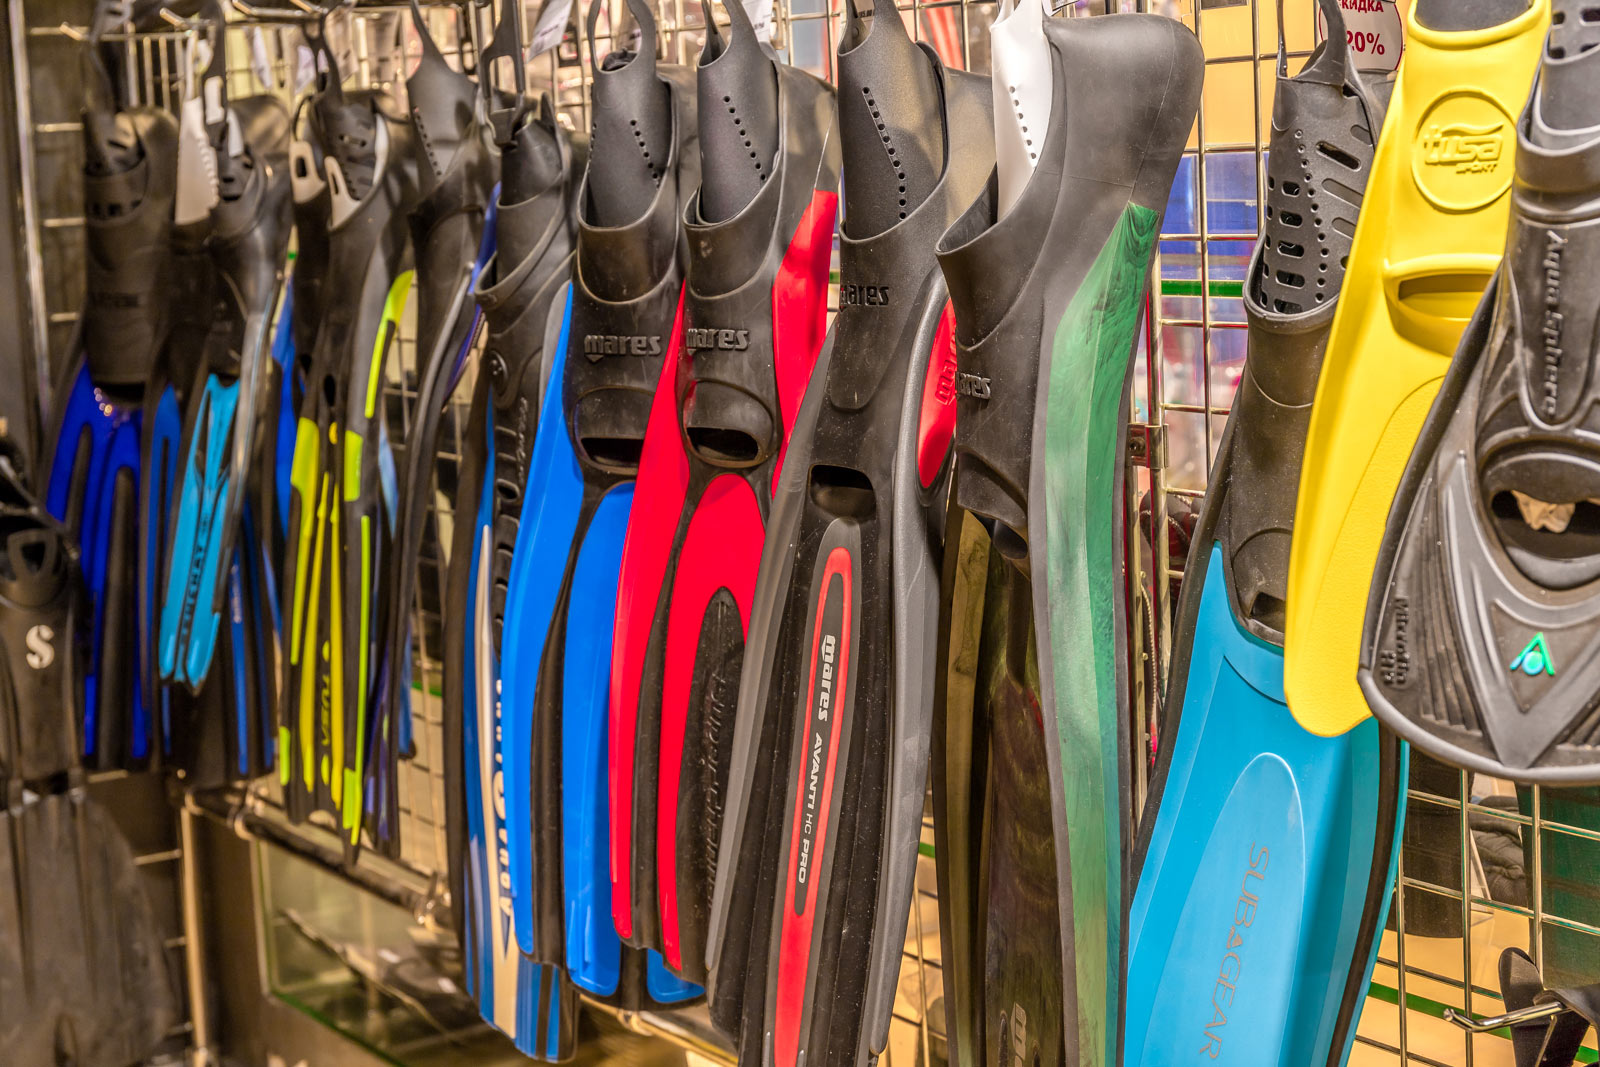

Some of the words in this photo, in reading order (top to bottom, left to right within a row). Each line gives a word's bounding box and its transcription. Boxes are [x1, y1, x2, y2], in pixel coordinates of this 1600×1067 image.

[1340, 0, 1384, 13] КИДКА
[1543, 229, 1569, 305] Aqua
[584, 334, 662, 361] mares
[686, 328, 749, 352] mares
[1542, 309, 1564, 416] Sphere
[818, 634, 836, 722] mares
[807, 732, 823, 810] AVANTI
[804, 813, 813, 835] HC
[799, 838, 811, 885] PRO
